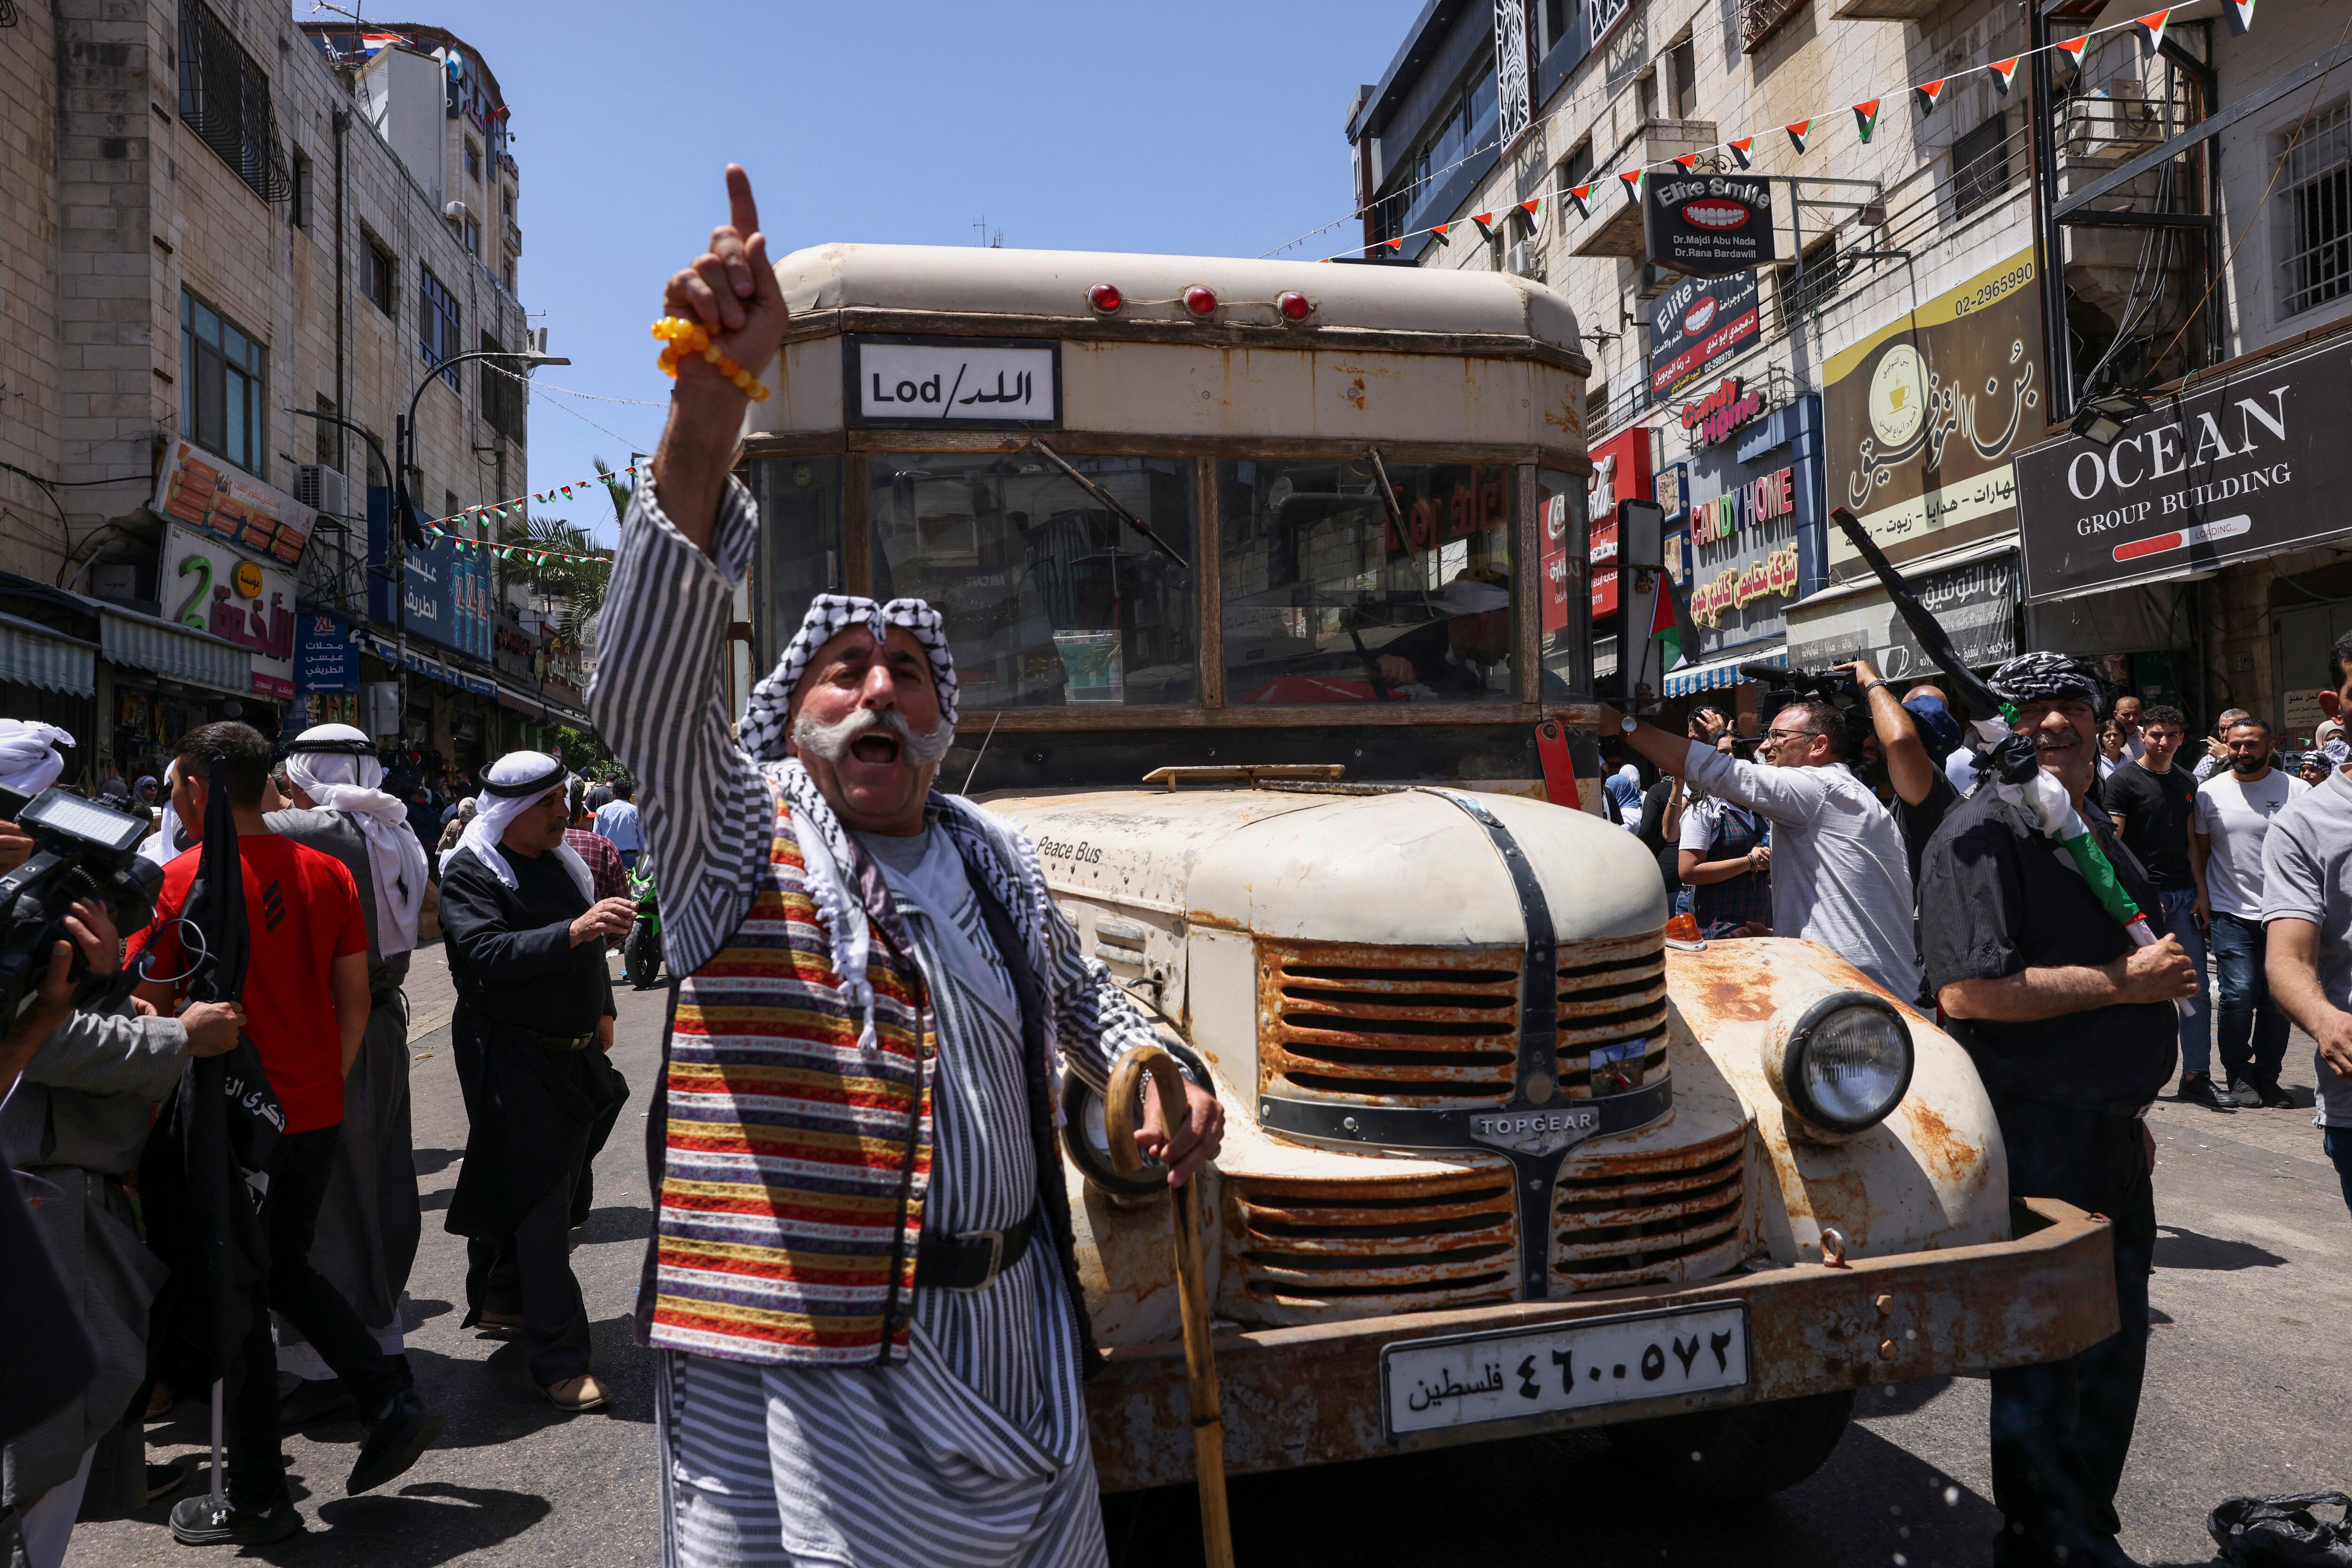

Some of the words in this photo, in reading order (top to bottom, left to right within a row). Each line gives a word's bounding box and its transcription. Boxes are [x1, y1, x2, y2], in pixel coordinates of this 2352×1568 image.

[1656, 181, 1705, 208] Elite
[1709, 177, 1770, 209] Smile
[1673, 235, 1710, 246] Dr.Majdi
[1713, 236, 1731, 245] Abu
[1733, 237, 1756, 245] Nada
[1675, 248, 1712, 257] Dr.Rana
[1714, 249, 1756, 258] Bardawill
[1719, 293, 1740, 311] وجراحة
[1741, 280, 1755, 299] لطب
[1955, 263, 2033, 316] 02-2965990
[1657, 284, 1692, 334] Elite
[1652, 339, 1671, 359] والاسنان
[1672, 329, 1683, 347] الفم
[1656, 362, 1676, 386] البردويل
[1704, 348, 1734, 373] 02-2989791
[1883, 356, 1899, 379] التوفيق
[1681, 377, 1739, 429] Candy
[1850, 375, 1967, 507] التوفيق
[1893, 422, 1905, 438] أنواع
[2068, 385, 2290, 500] OCEAN
[1691, 488, 1741, 547] CANDY
[1744, 467, 1795, 528] HOME
[1974, 480, 2015, 504] هارات
[2077, 501, 2151, 535] GROUP
[2161, 462, 2292, 515] BUILDING
[1886, 513, 1912, 533] زيوت
[1927, 498, 1957, 523] هدايا
[2195, 523, 2237, 540] LOADING...
[240, 571, 260, 590] مؤسسة
[404, 556, 437, 582] عيس
[1768, 542, 1797, 597] شركة
[1989, 564, 2008, 596] بن
[179, 557, 212, 630] 2
[455, 575, 464, 610] XL
[466, 572, 477, 612] XL
[1708, 569, 1735, 628] كاندي
[1734, 563, 1769, 609] محامص
[1923, 565, 1984, 611] التوفيق
[405, 585, 437, 621] الطريف
[478, 588, 486, 621] XL
[1691, 585, 1708, 627] هوم
[314, 615, 335, 631] XL
[306, 665, 343, 677] الطريفي
[1037, 836, 1073, 860] Peace
[1075, 841, 1102, 863] Bus
[242, 1092, 285, 1133] ذكرى
[1481, 1113, 1591, 1134] TOPGEAR
[1409, 1363, 1503, 1411] فلسطين
